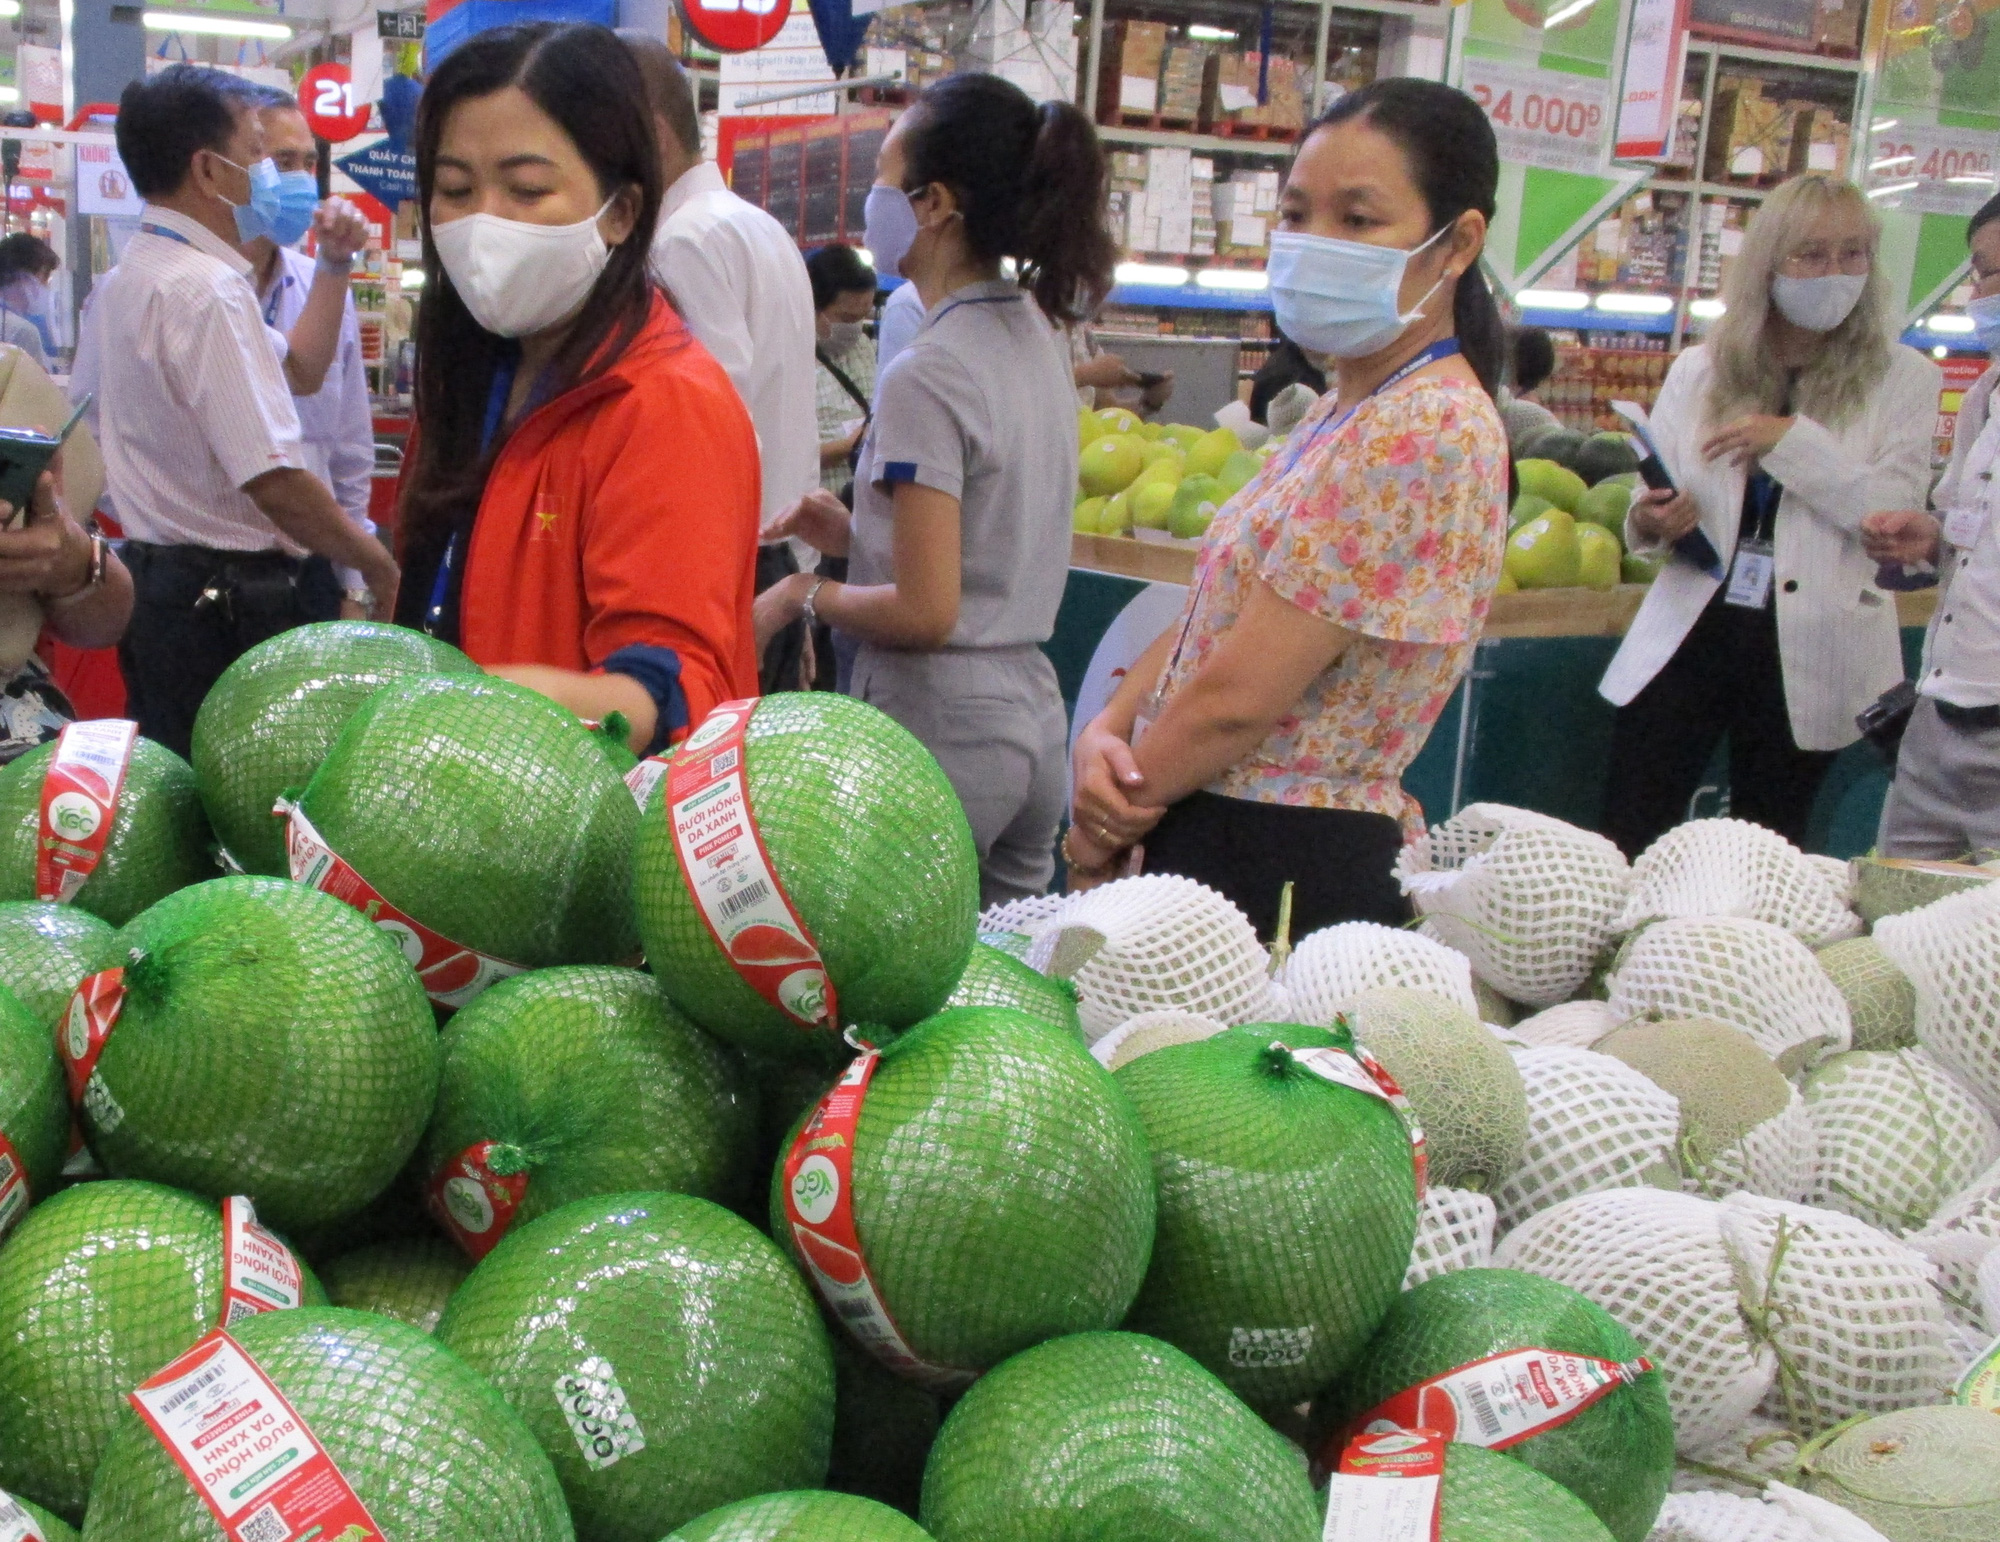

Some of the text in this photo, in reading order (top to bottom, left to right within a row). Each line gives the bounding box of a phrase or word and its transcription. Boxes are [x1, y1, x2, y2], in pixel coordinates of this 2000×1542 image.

[315, 79, 353, 117] 21
[348, 163, 415, 181] THANH TOÁN
[678, 792, 741, 834] BƯỞI HỒNG
[688, 810, 737, 843] DA XANH
[699, 829, 738, 856] PINK POMELO
[243, 1239, 275, 1263] XANH
[233, 1253, 298, 1290] HỒNG BƯỞI
[1547, 1355, 1561, 1373] DA
[199, 1406, 256, 1445] PINK POMELO
[203, 1412, 275, 1465] DA XANH
[204, 1420, 296, 1487] BƯỞI HỒNG
